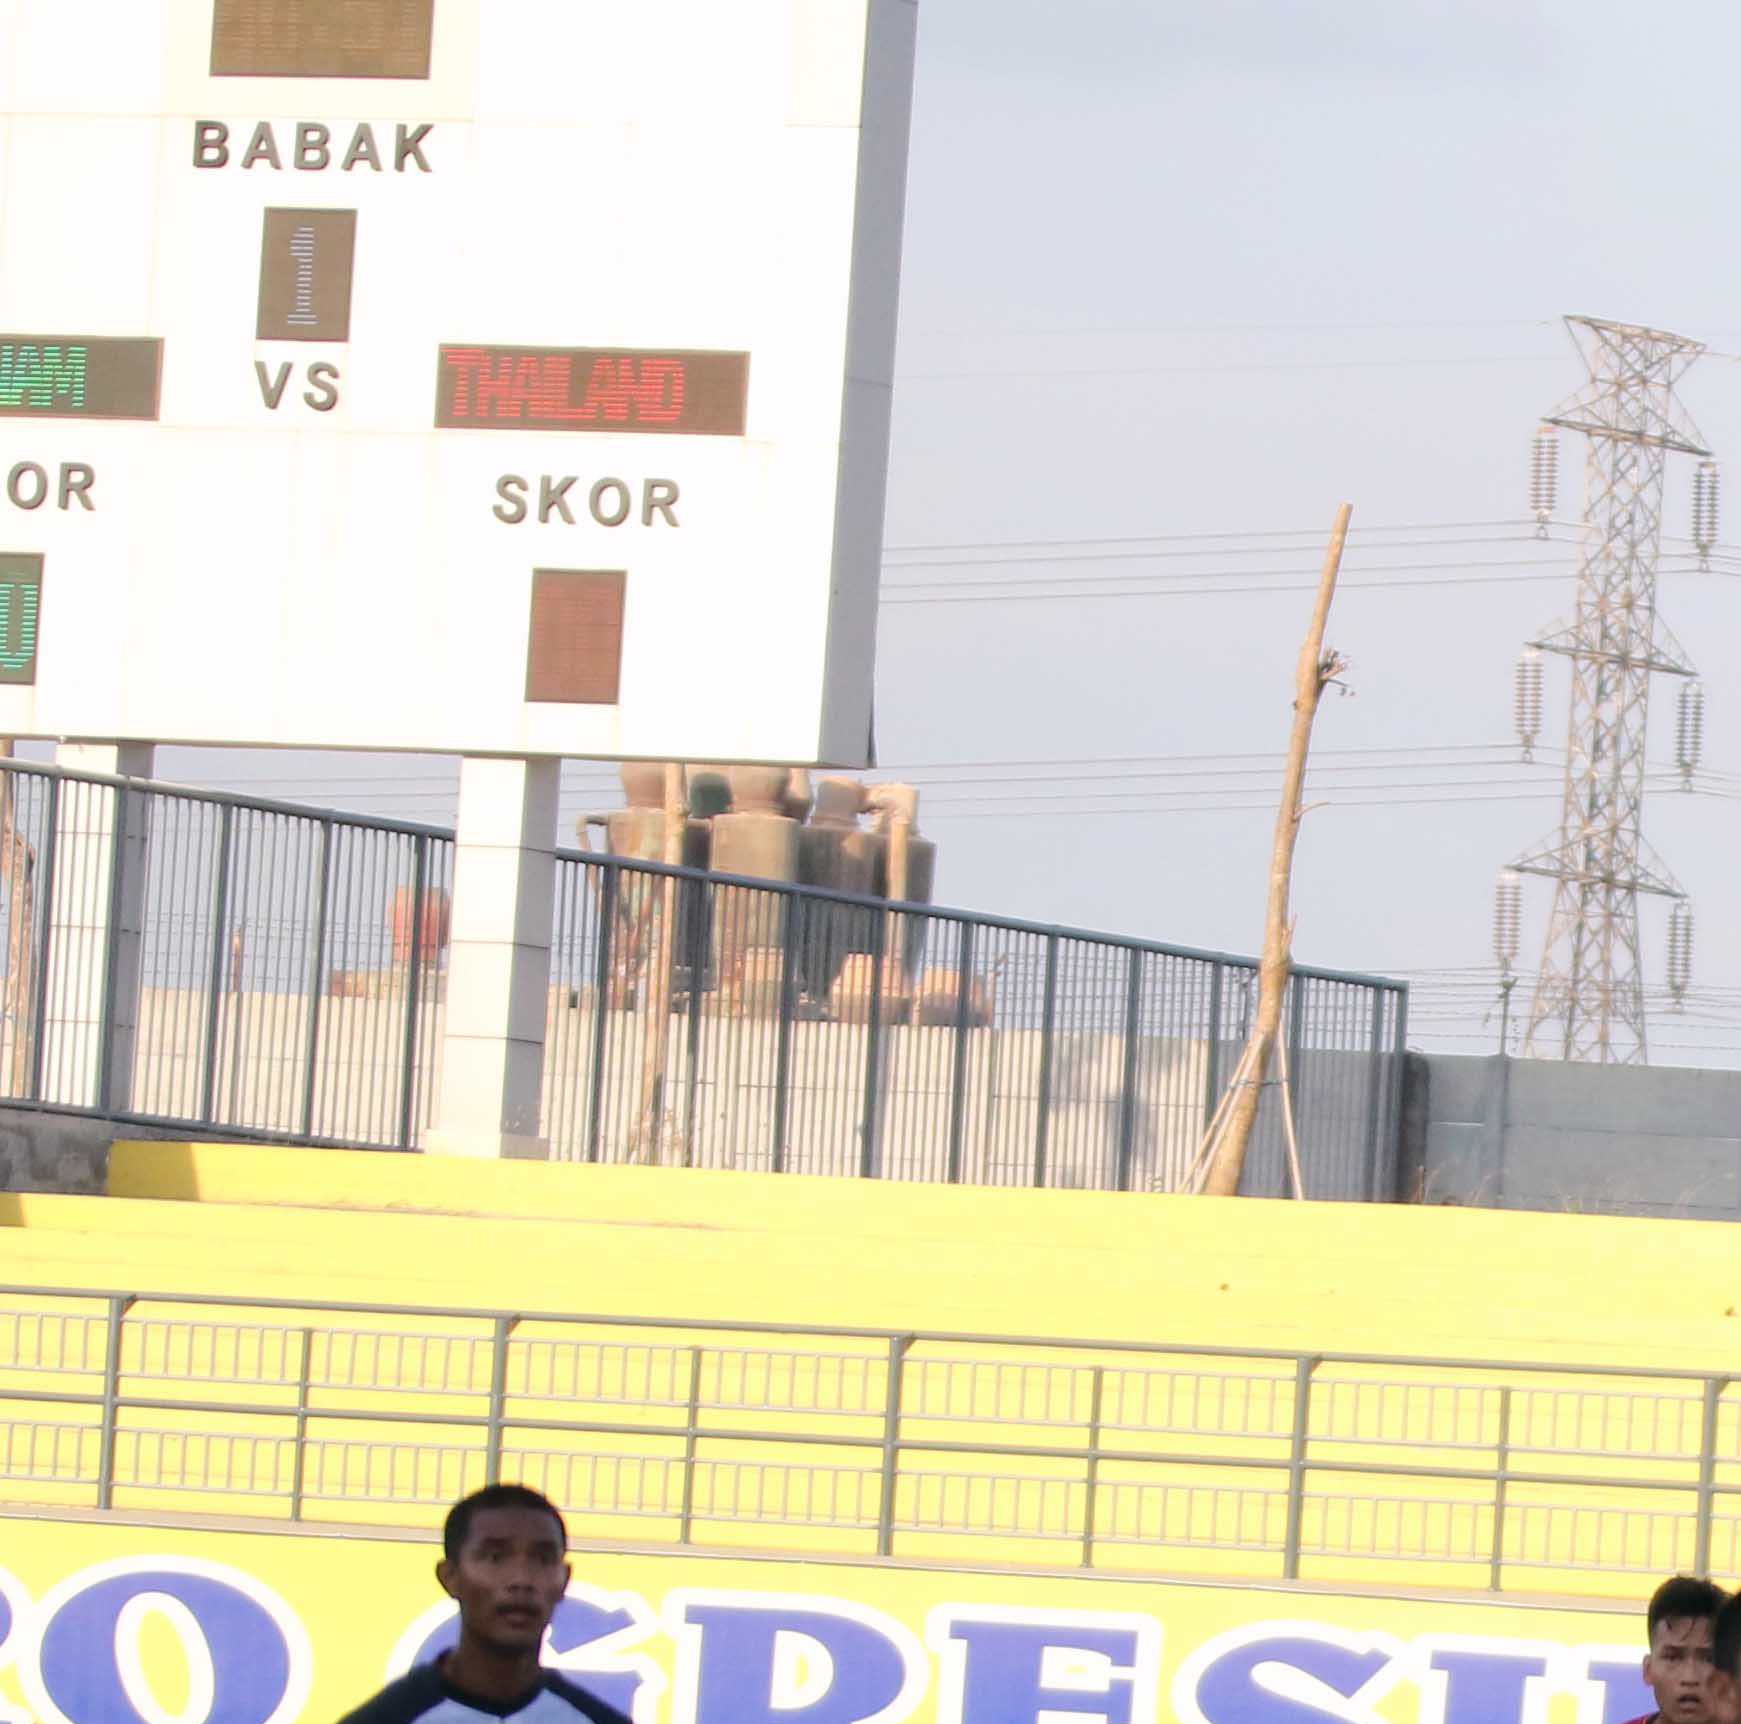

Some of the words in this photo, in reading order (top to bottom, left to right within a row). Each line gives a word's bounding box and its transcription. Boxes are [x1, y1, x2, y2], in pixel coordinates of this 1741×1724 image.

[192, 119, 434, 173] BABAK
[287, 226, 319, 325] 1
[254, 360, 340, 412] VS
[441, 347, 686, 422] THAILAND
[492, 474, 680, 528] SKOR
